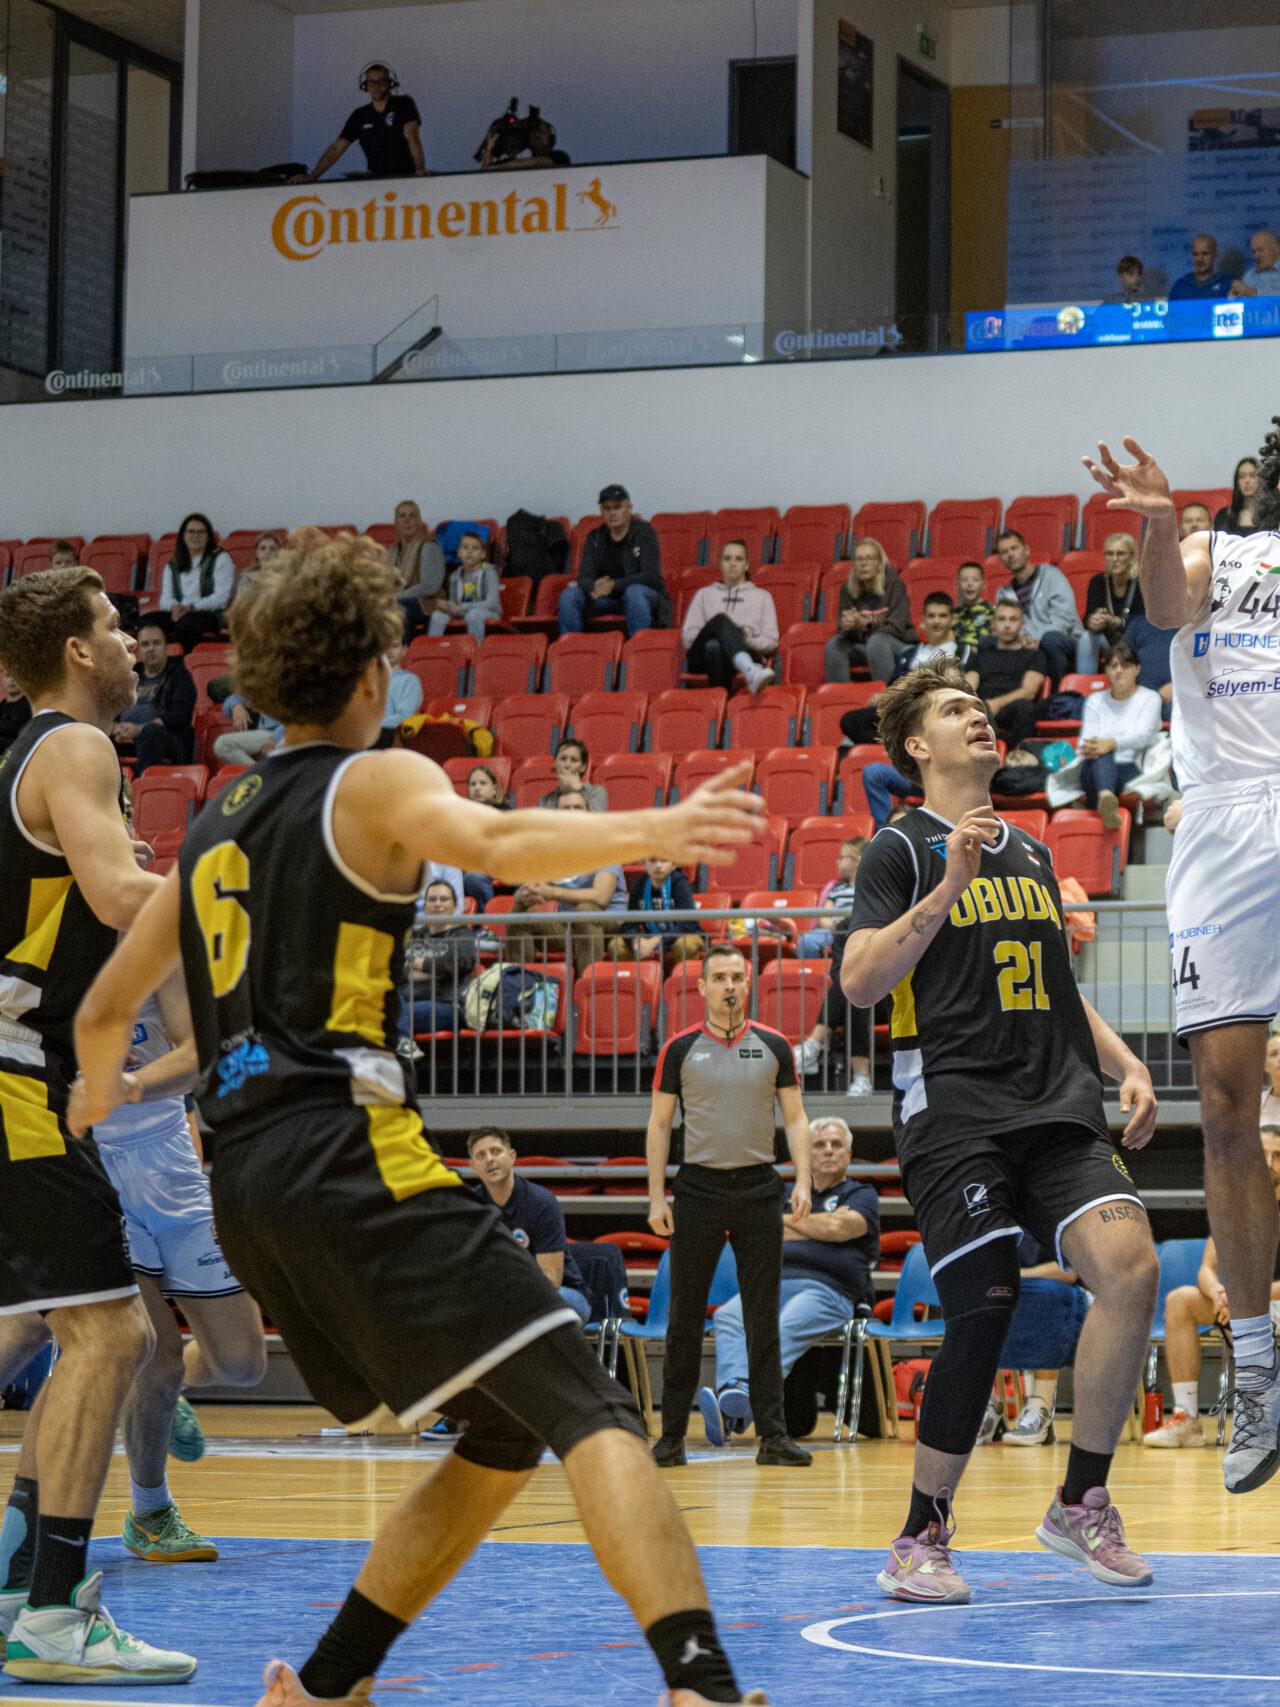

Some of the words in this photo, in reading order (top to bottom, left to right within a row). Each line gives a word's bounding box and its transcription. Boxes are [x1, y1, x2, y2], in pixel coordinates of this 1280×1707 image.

[271, 182, 570, 262] Continental
[774, 327, 885, 356] Continental
[222, 355, 325, 384] Continental
[1218, 559, 1243, 570] AKO
[191, 838, 251, 999] 6
[993, 940, 1051, 1012] 21
